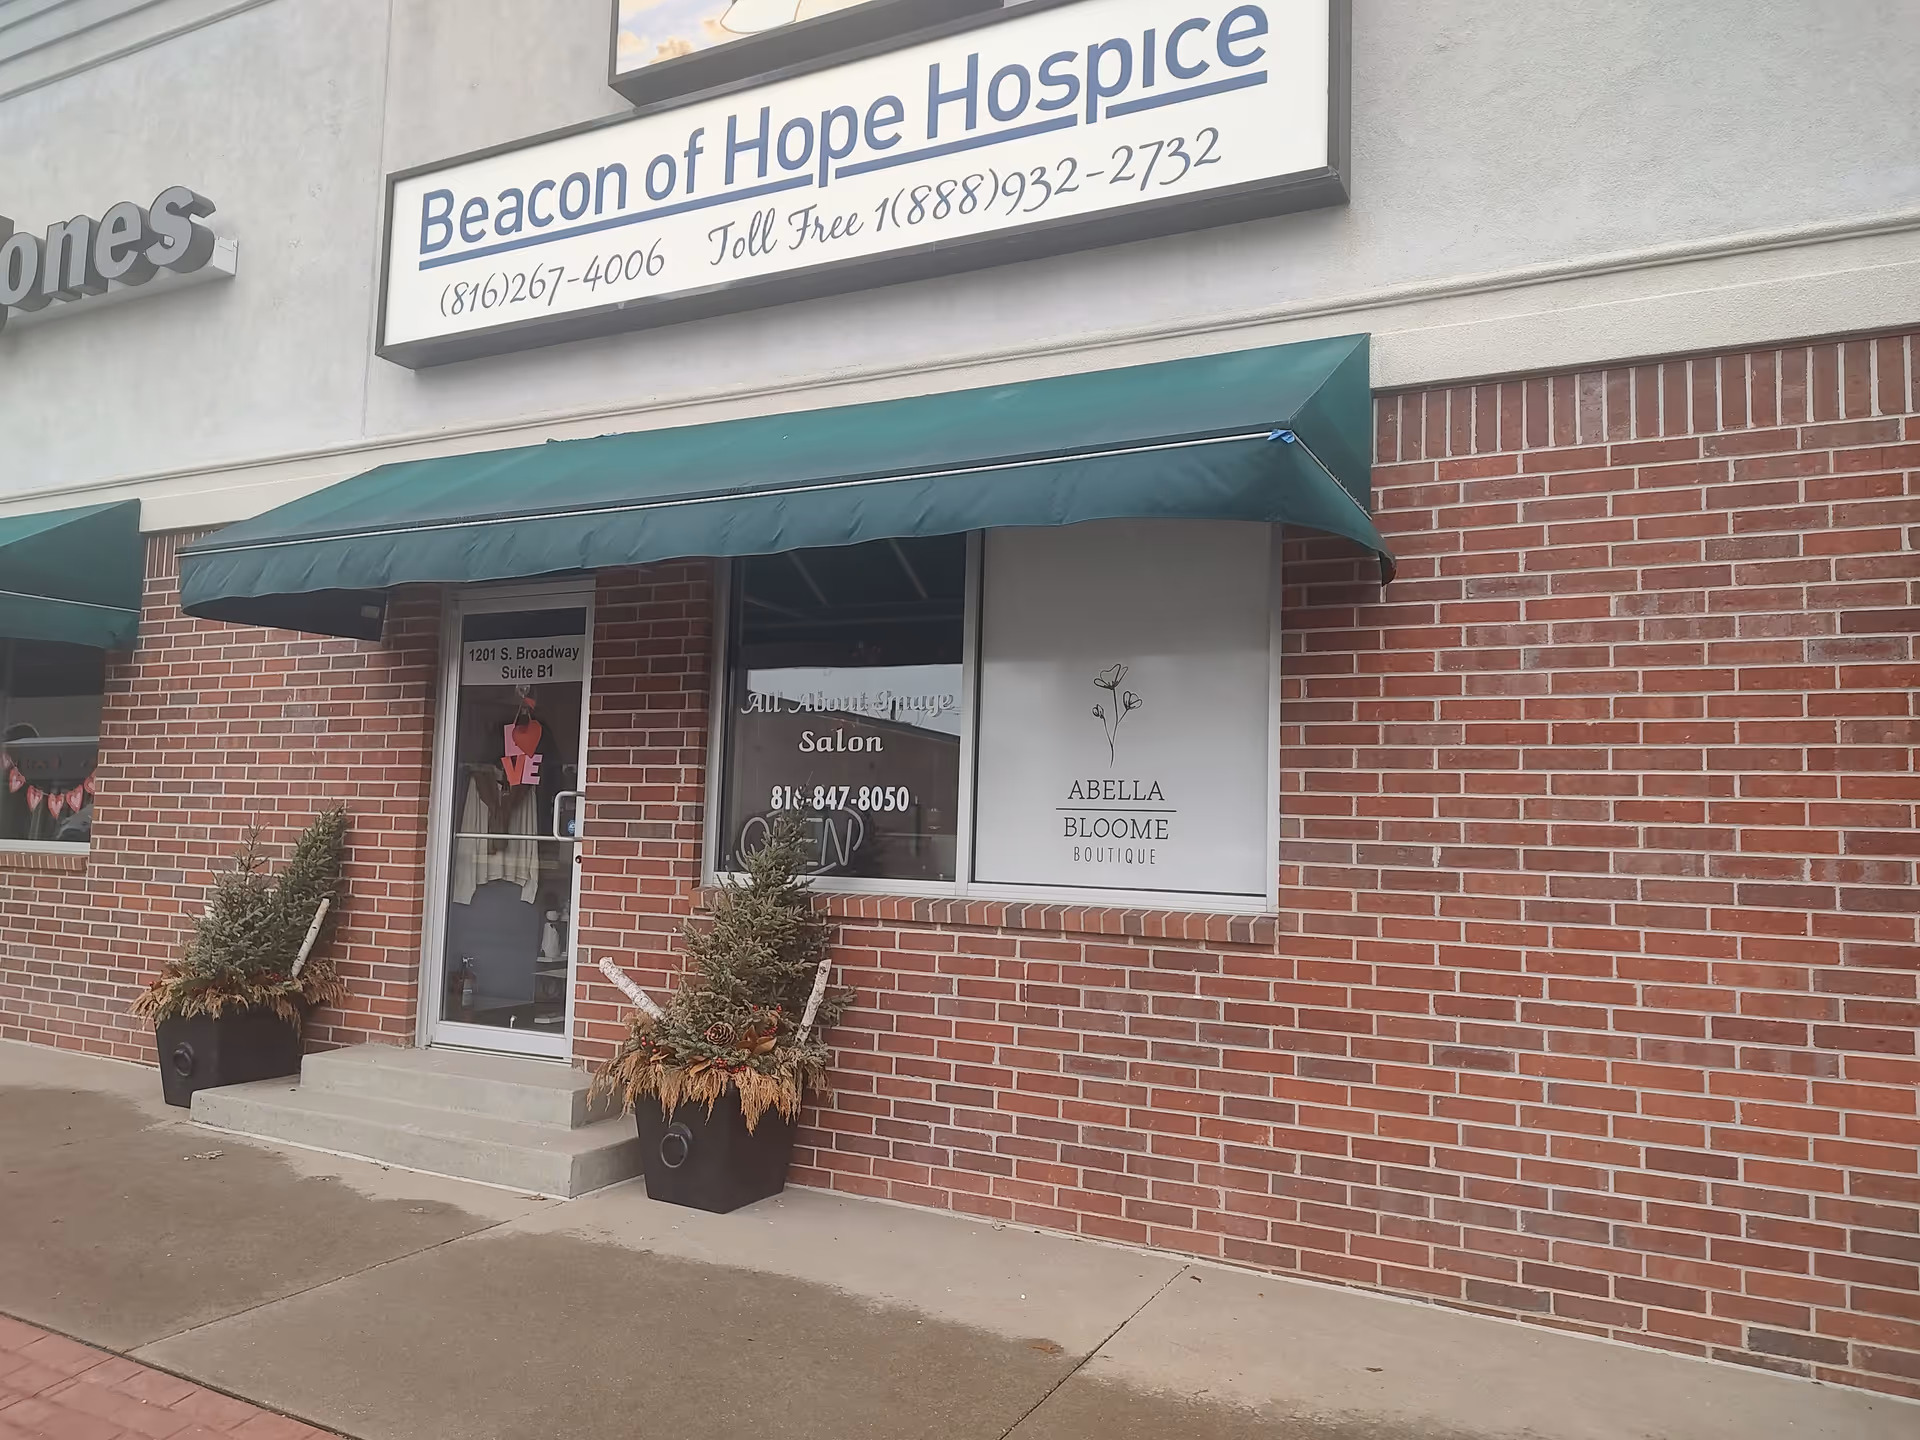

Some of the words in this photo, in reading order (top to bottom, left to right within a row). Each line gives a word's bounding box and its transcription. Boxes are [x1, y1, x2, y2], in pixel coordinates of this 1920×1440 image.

[420, 162, 627, 255] Beacon
[646, 127, 705, 202] of
[724, 95, 904, 188] Hope
[927, 4, 1269, 139] Hospice
[440, 238, 665, 317] (816)267-4006
[708, 207, 777, 266] Toll
[788, 203, 865, 251] Free
[874, 127, 1223, 232] 1(888)932-2732
[0, 185, 217, 314] ones
[469, 648, 496, 662] 1201
[500, 647, 512, 660] S.
[516, 645, 579, 661] Broadway
[501, 665, 533, 679] Suite
[537, 664, 553, 678] B1
[740, 691, 781, 714] All
[788, 690, 868, 713] About
[872, 690, 954, 717] Image
[798, 727, 884, 752] Salon
[1067, 780, 1165, 801] ABELLA
[1063, 817, 1169, 840] BLOOME
[741, 817, 852, 866] OEN
[1073, 846, 1156, 865] BOUTIQUE
